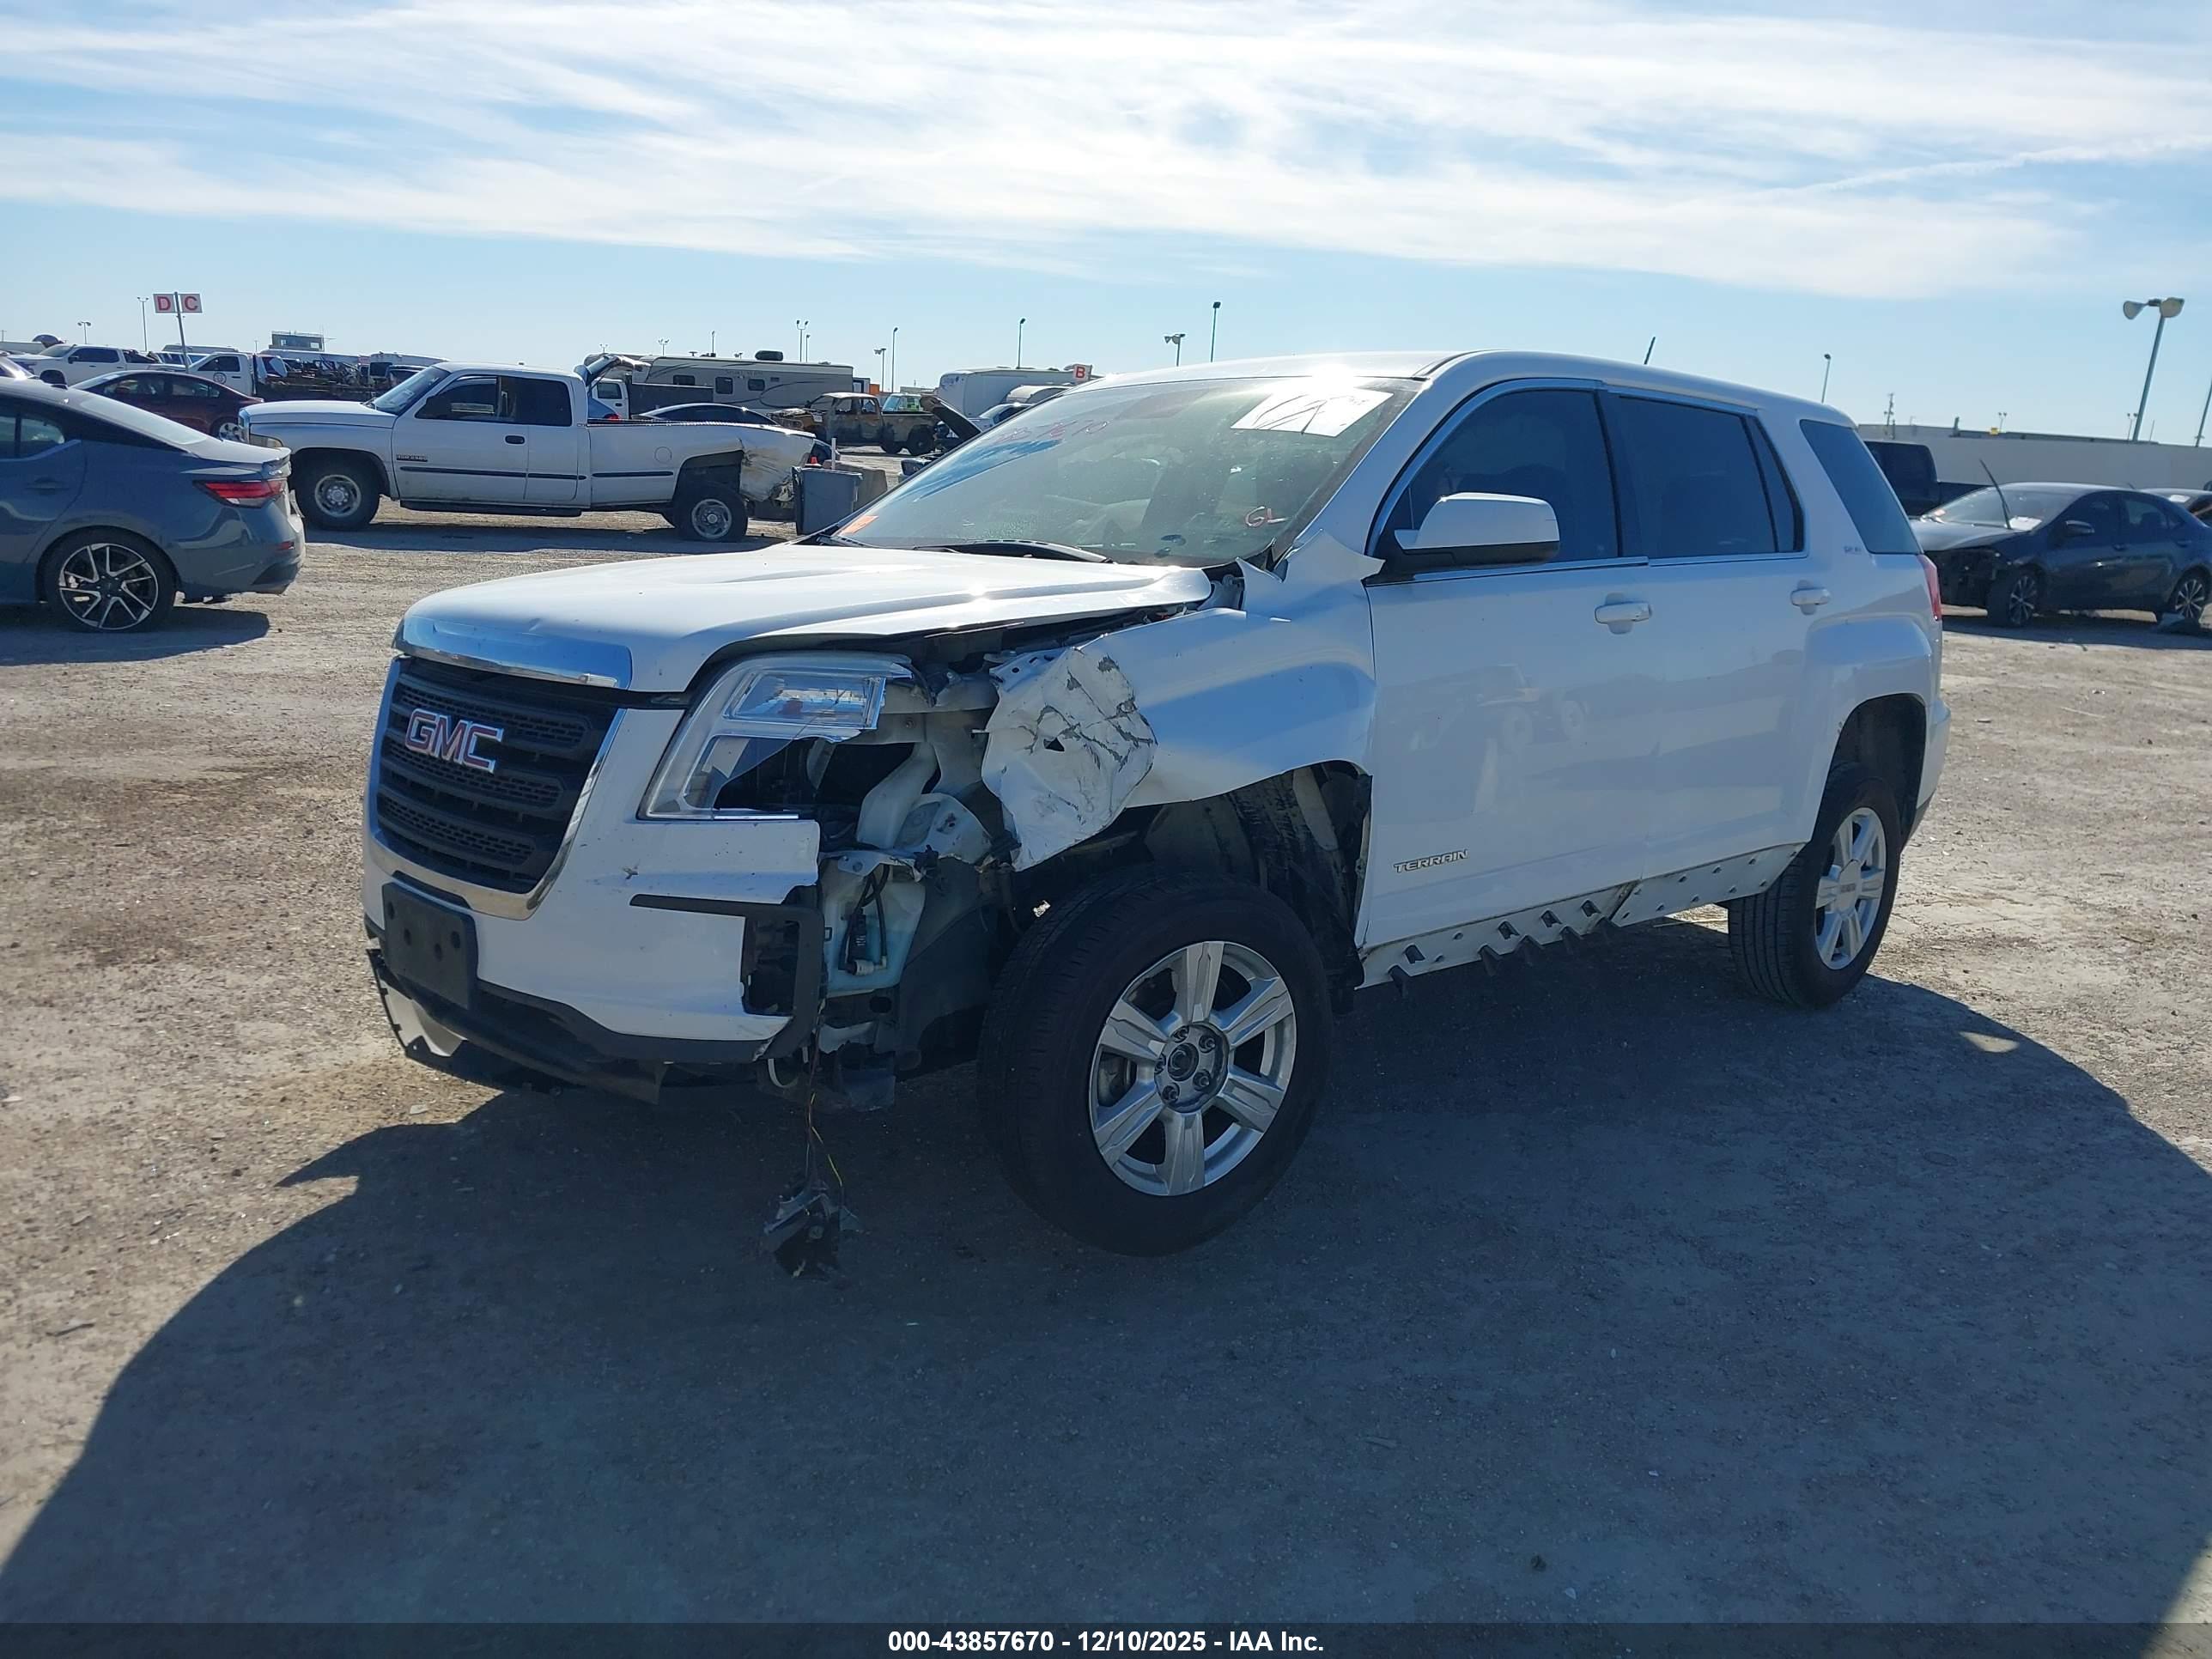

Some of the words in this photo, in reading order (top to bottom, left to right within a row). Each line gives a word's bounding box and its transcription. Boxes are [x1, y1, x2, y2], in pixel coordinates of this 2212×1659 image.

[157, 296, 171, 311] D
[184, 295, 198, 310] C
[1076, 366, 1085, 379] B
[405, 708, 504, 774] GMC
[1393, 848, 1468, 872] TERRAIN
